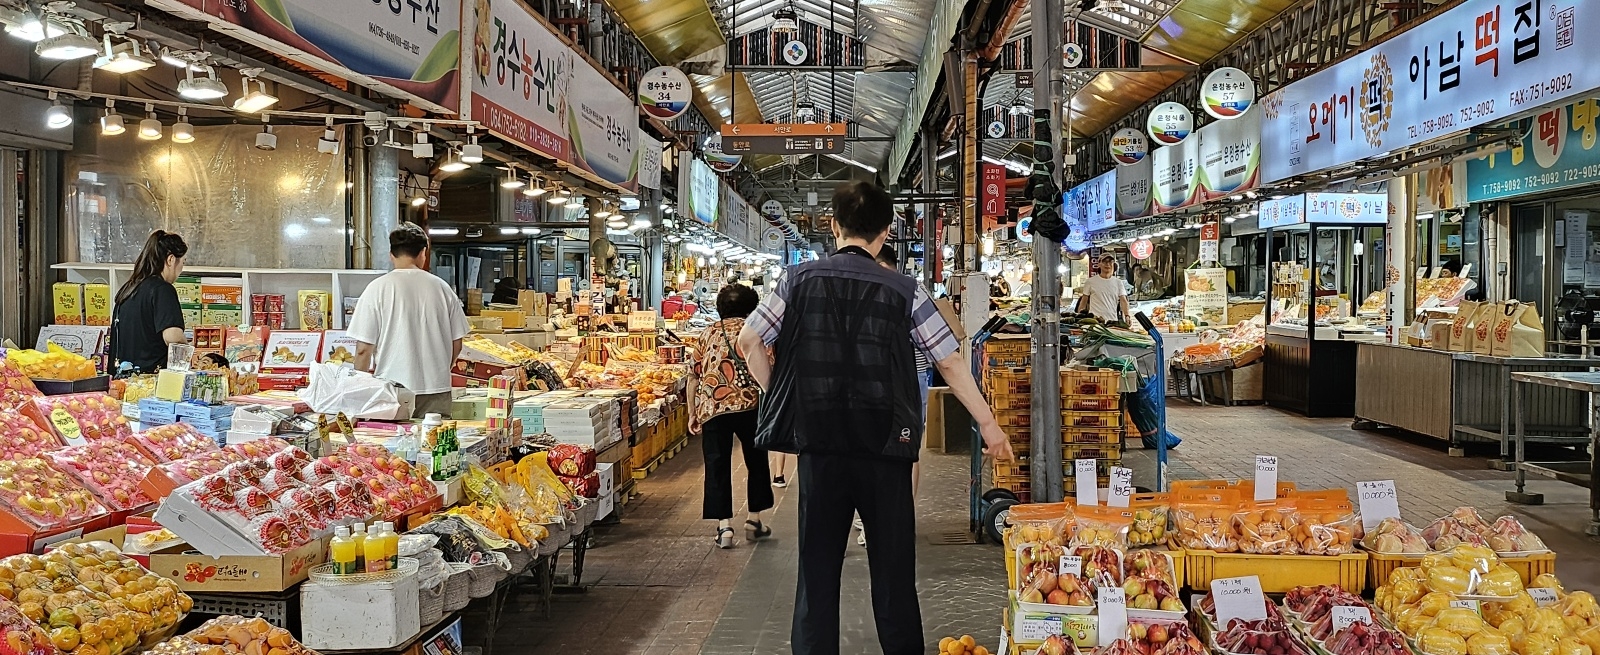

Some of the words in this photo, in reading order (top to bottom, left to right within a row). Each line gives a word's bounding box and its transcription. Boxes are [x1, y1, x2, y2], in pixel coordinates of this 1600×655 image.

[493, 16, 556, 114] 경수농수산
[1305, 86, 1355, 145] 오메기
[1409, 0, 1540, 101] 아남떡집
[647, 81, 682, 91] 경수농수산
[657, 91, 671, 101] 34
[1222, 92, 1235, 101] 57
[1460, 98, 1495, 124] 752-9092
[1509, 72, 1573, 108] FAX:751-9092
[606, 114, 632, 153] 경수농수산
[1165, 122, 1177, 130] 55
[827, 141, 834, 150] 8
[1482, 178, 1521, 195] T.758-9092
[1524, 171, 1560, 189] 752-9092
[1310, 200, 1337, 216] 오메기
[1363, 200, 1383, 215] 아남
